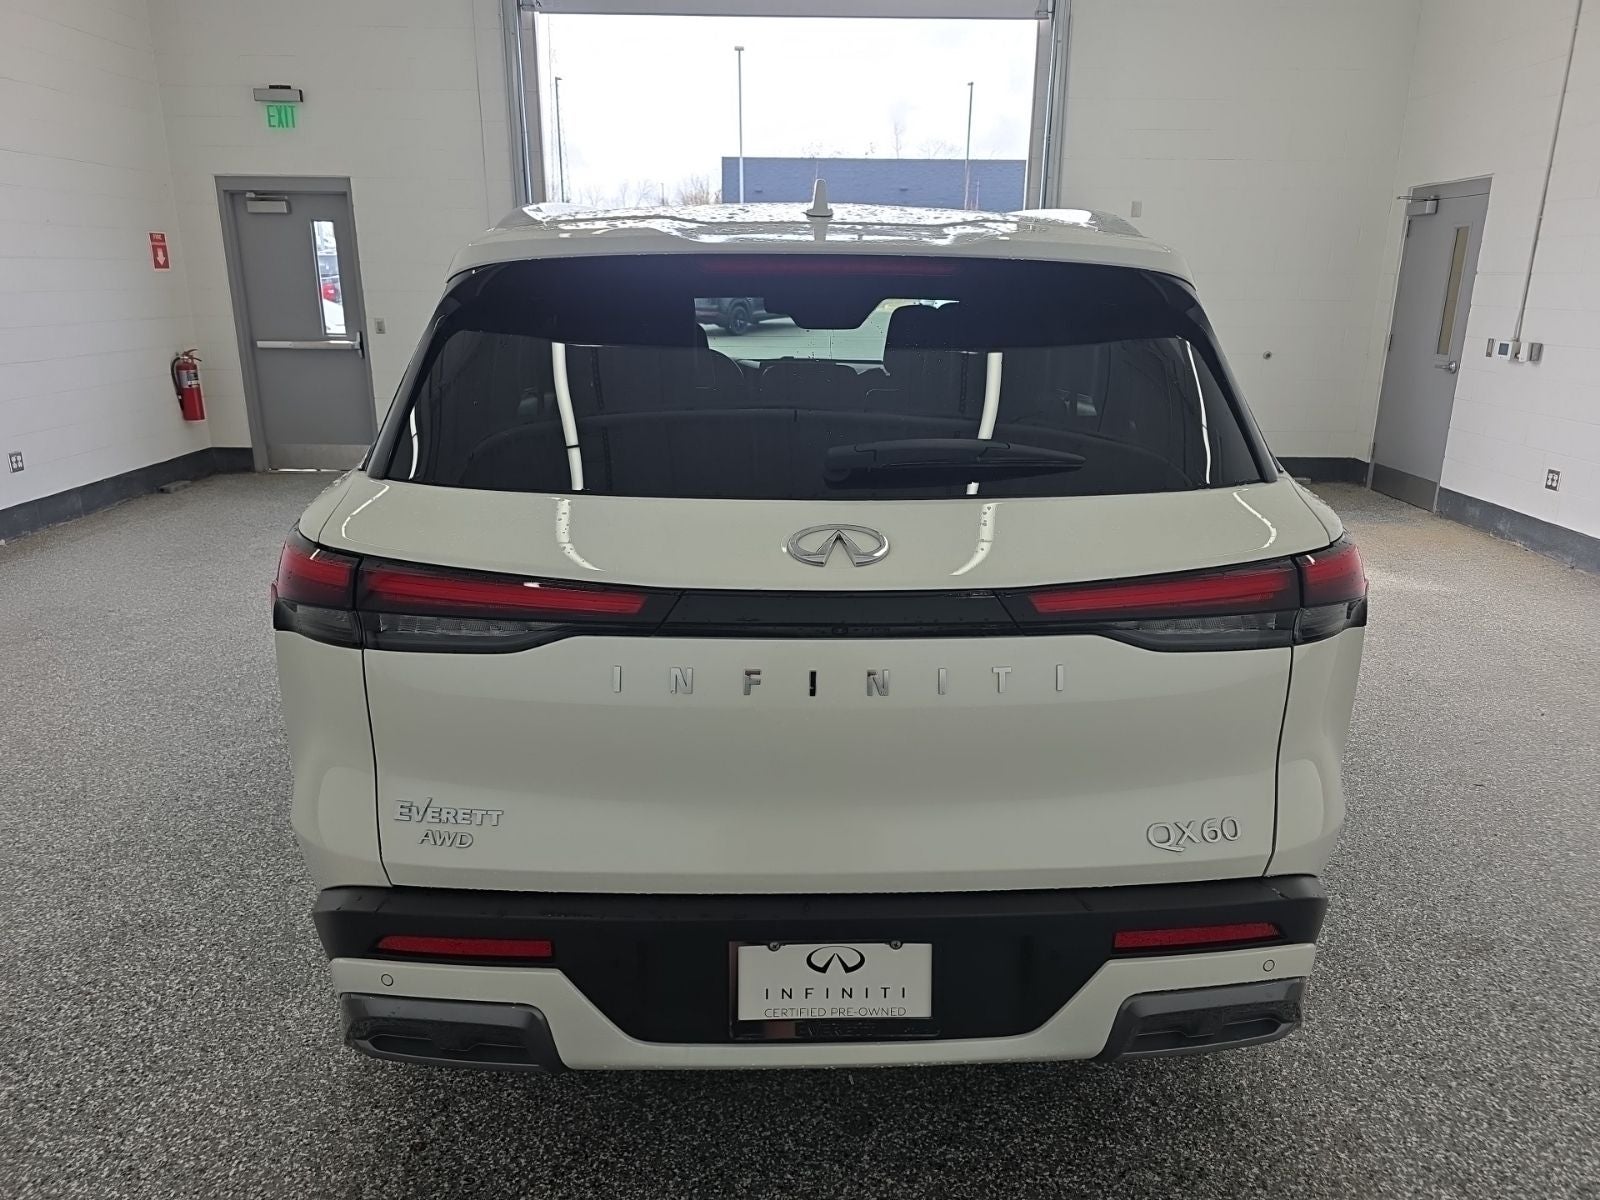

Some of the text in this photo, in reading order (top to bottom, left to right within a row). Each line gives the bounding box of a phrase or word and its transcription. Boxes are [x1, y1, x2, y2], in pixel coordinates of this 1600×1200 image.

[267, 105, 296, 128] EXIT
[613, 665, 1065, 697] INFINITI
[394, 797, 504, 826] EVERETT
[419, 829, 474, 848] AWD
[1146, 816, 1240, 852] QX60
[765, 987, 906, 999] INFINITI
[764, 1007, 907, 1017] CERTIFIED PRE-OWNED
